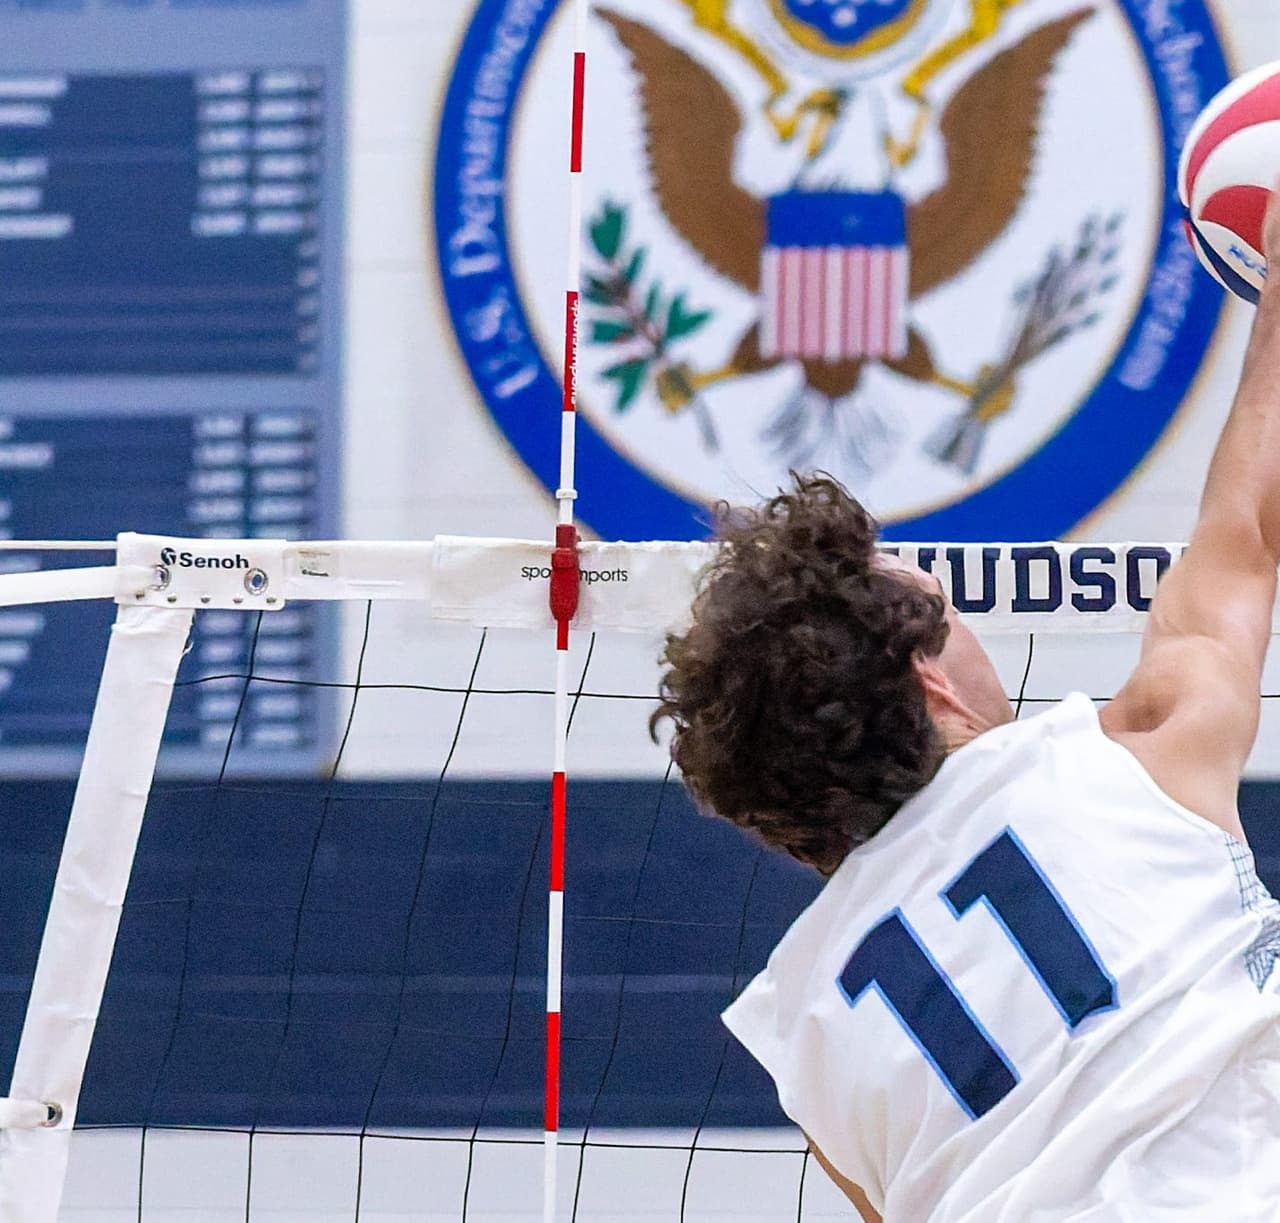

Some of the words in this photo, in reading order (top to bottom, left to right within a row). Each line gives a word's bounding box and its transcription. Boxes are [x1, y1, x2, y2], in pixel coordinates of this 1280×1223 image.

[179, 552, 249, 569] Senoh
[521, 565, 628, 585] spomports
[890, 546, 1187, 613] UDSO
[835, 824, 1121, 1121] 11
